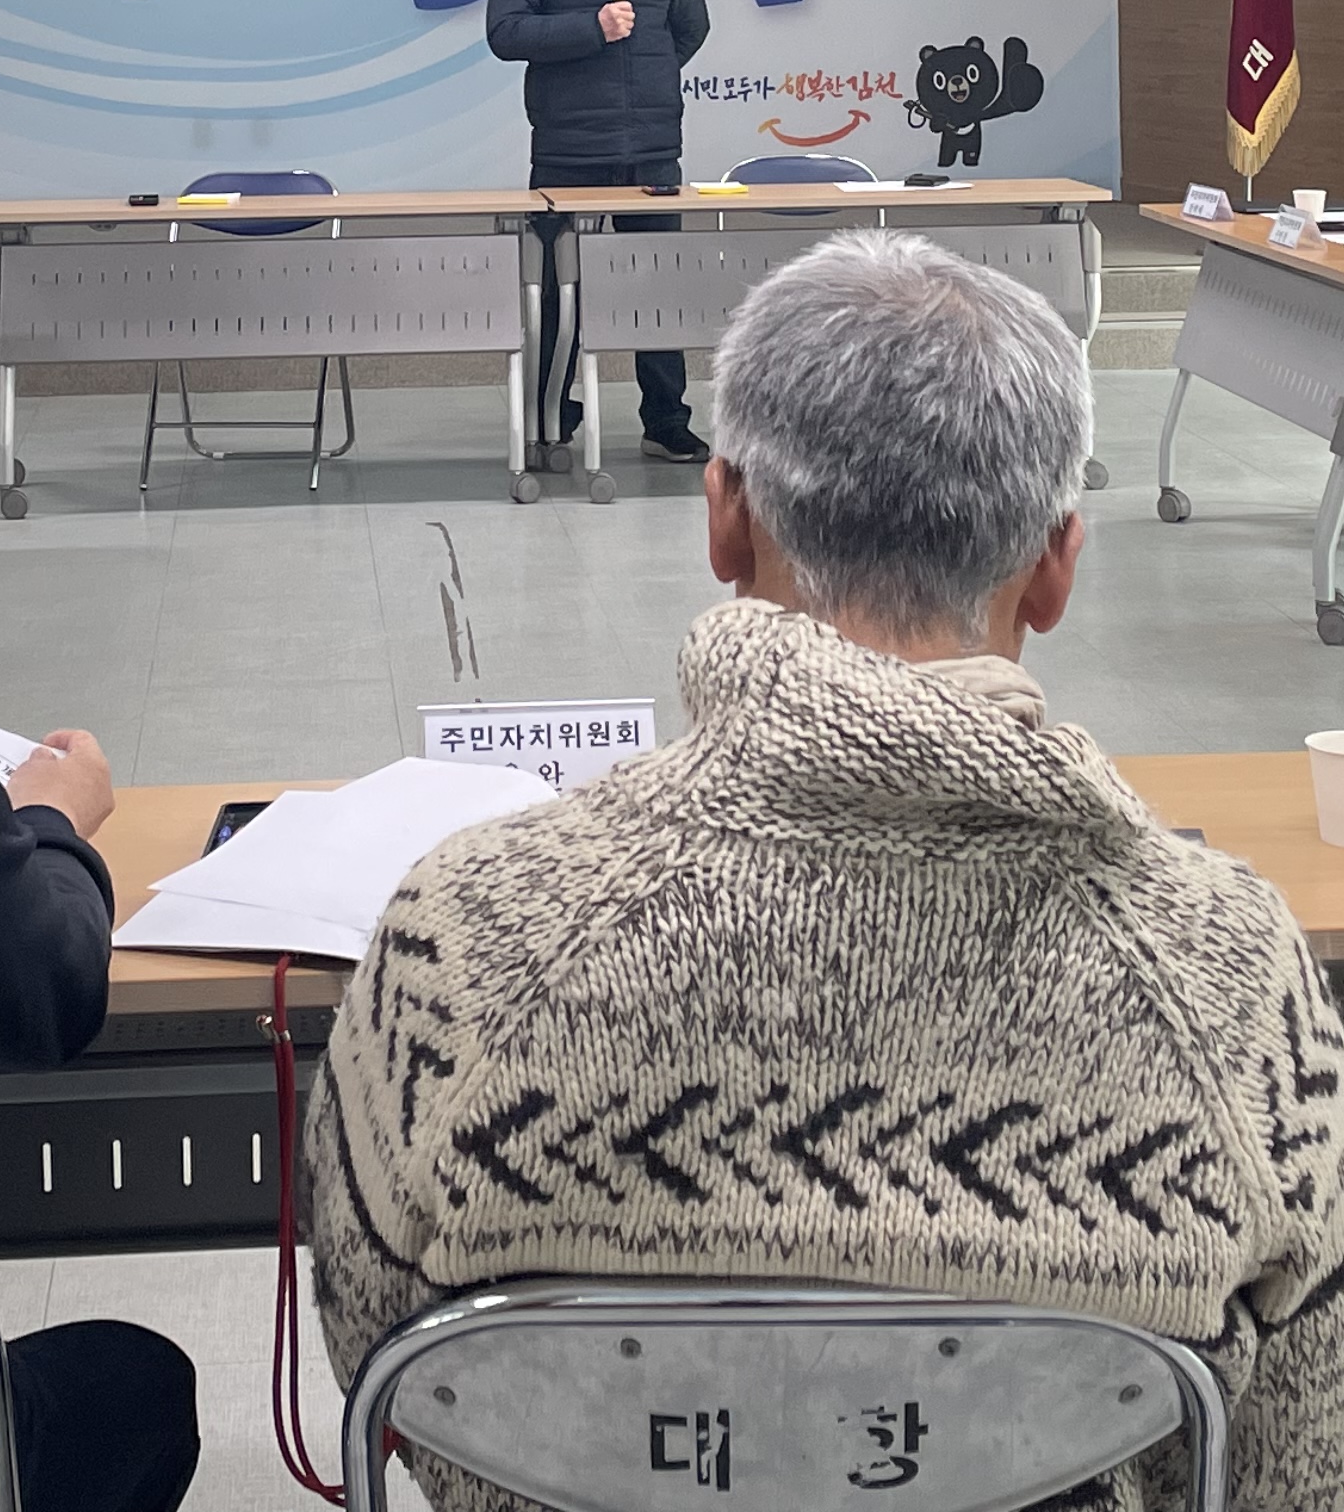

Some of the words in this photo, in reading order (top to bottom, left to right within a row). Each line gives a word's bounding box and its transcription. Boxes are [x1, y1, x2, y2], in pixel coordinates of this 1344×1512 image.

[682, 75, 718, 100] 시민
[722, 76, 776, 103] 모두가
[776, 69, 845, 102] 행복한
[846, 70, 904, 102] 김천
[439, 718, 642, 753] 주민자치위원회
